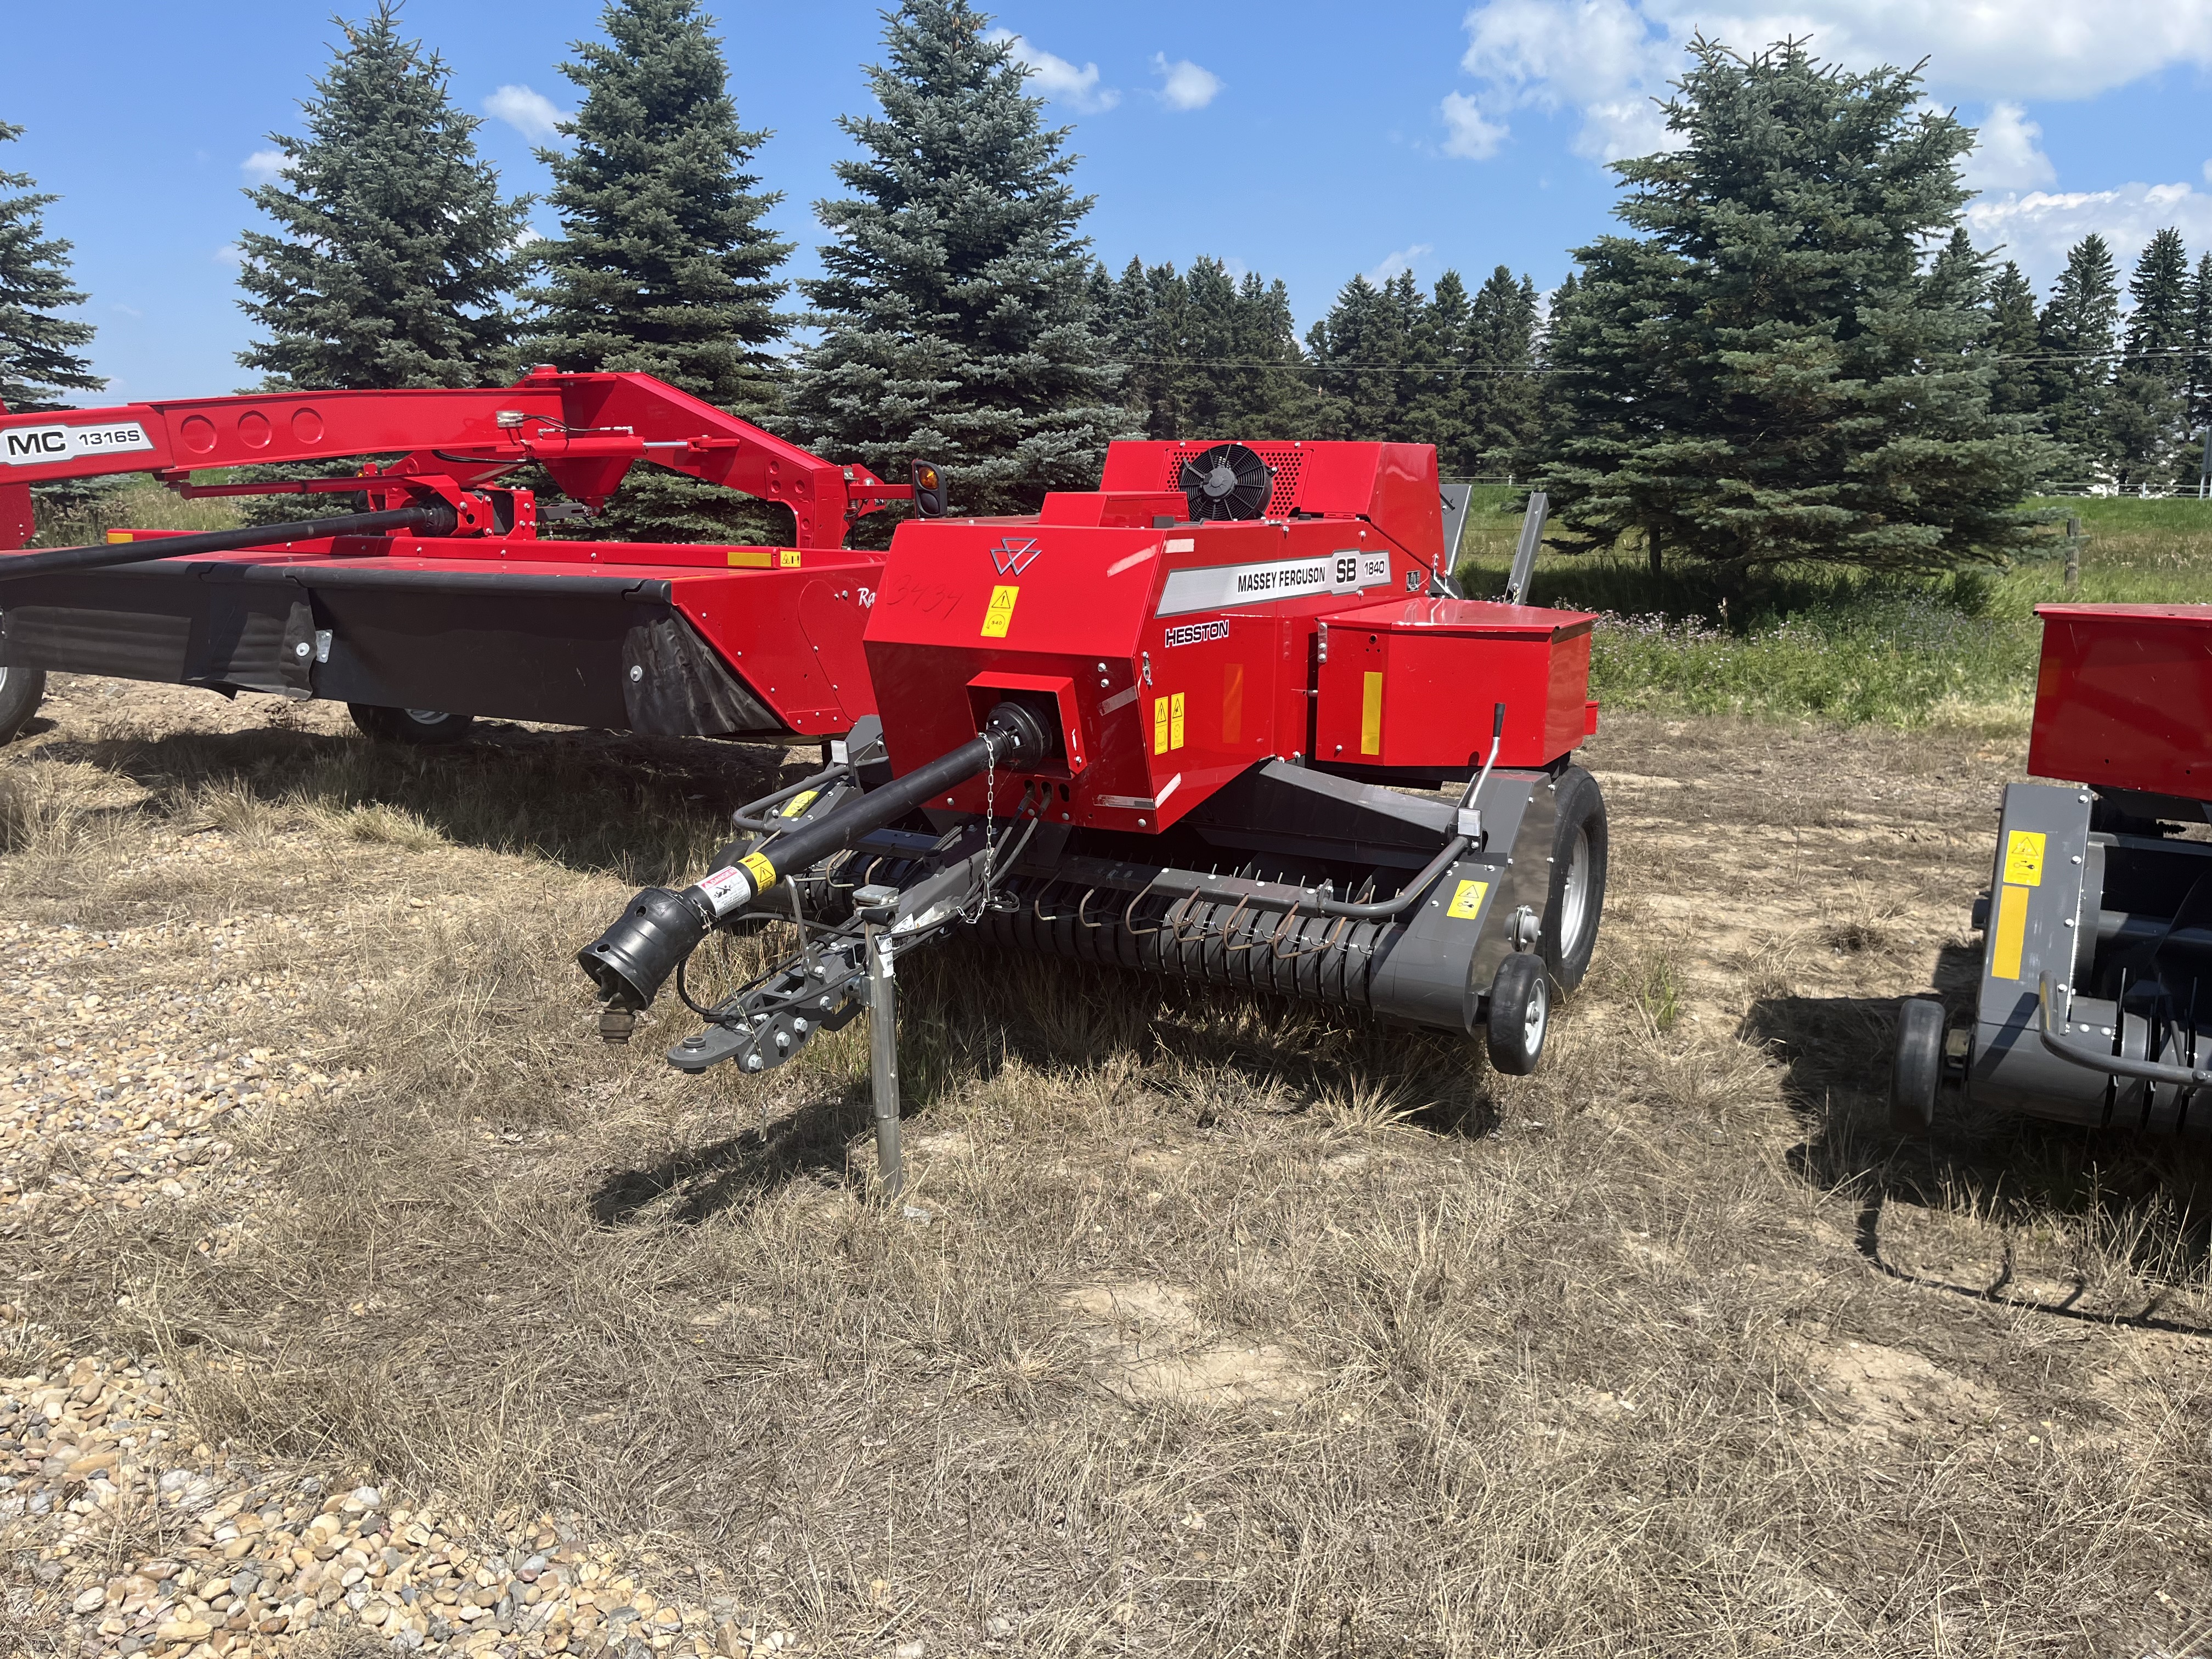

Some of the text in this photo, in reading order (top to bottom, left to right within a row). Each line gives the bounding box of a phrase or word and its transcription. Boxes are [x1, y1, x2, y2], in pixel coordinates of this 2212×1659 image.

[7, 430, 140, 455] MC 1316S
[1238, 557, 1385, 592] MASSEY FERGUSON SB 1840
[1165, 620, 1229, 647] HESSTON
[710, 868, 736, 885] DANGER
